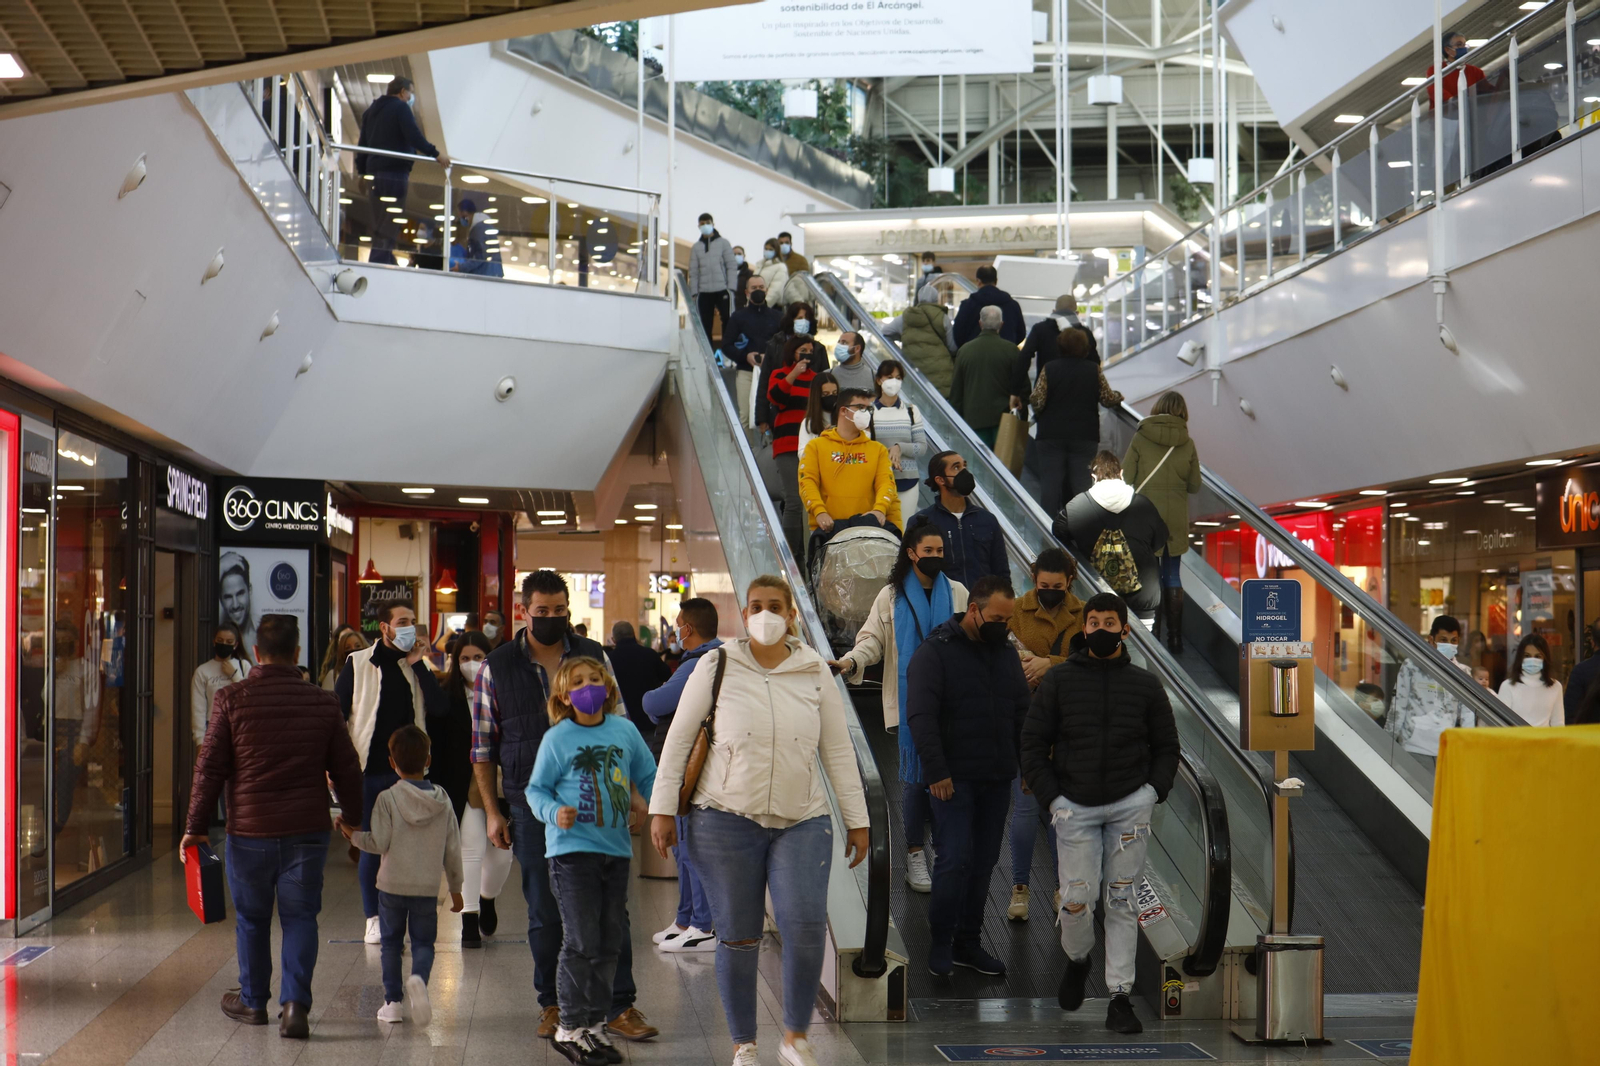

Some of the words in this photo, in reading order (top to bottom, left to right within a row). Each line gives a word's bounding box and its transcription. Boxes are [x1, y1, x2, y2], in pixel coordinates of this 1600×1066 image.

[780, 2, 849, 12] sostenibilidad
[851, 2, 864, 10] de
[866, 1, 875, 10] El
[877, 0, 924, 11] Arcángel.
[775, 21, 791, 30] plan
[793, 19, 829, 30] inspirado
[854, 18, 890, 27] Objetivos
[903, 17, 944, 25] Desarrollo
[793, 30, 833, 38] Sostenible
[846, 28, 882, 36] Naciones
[883, 27, 912, 35] Unidas.
[806, 51, 830, 59] grandes
[953, 227, 975, 244] EL
[167, 465, 208, 521] SPRINGFIELD
[264, 499, 319, 522] CLINICS
[576, 773, 596, 824] BEACH
